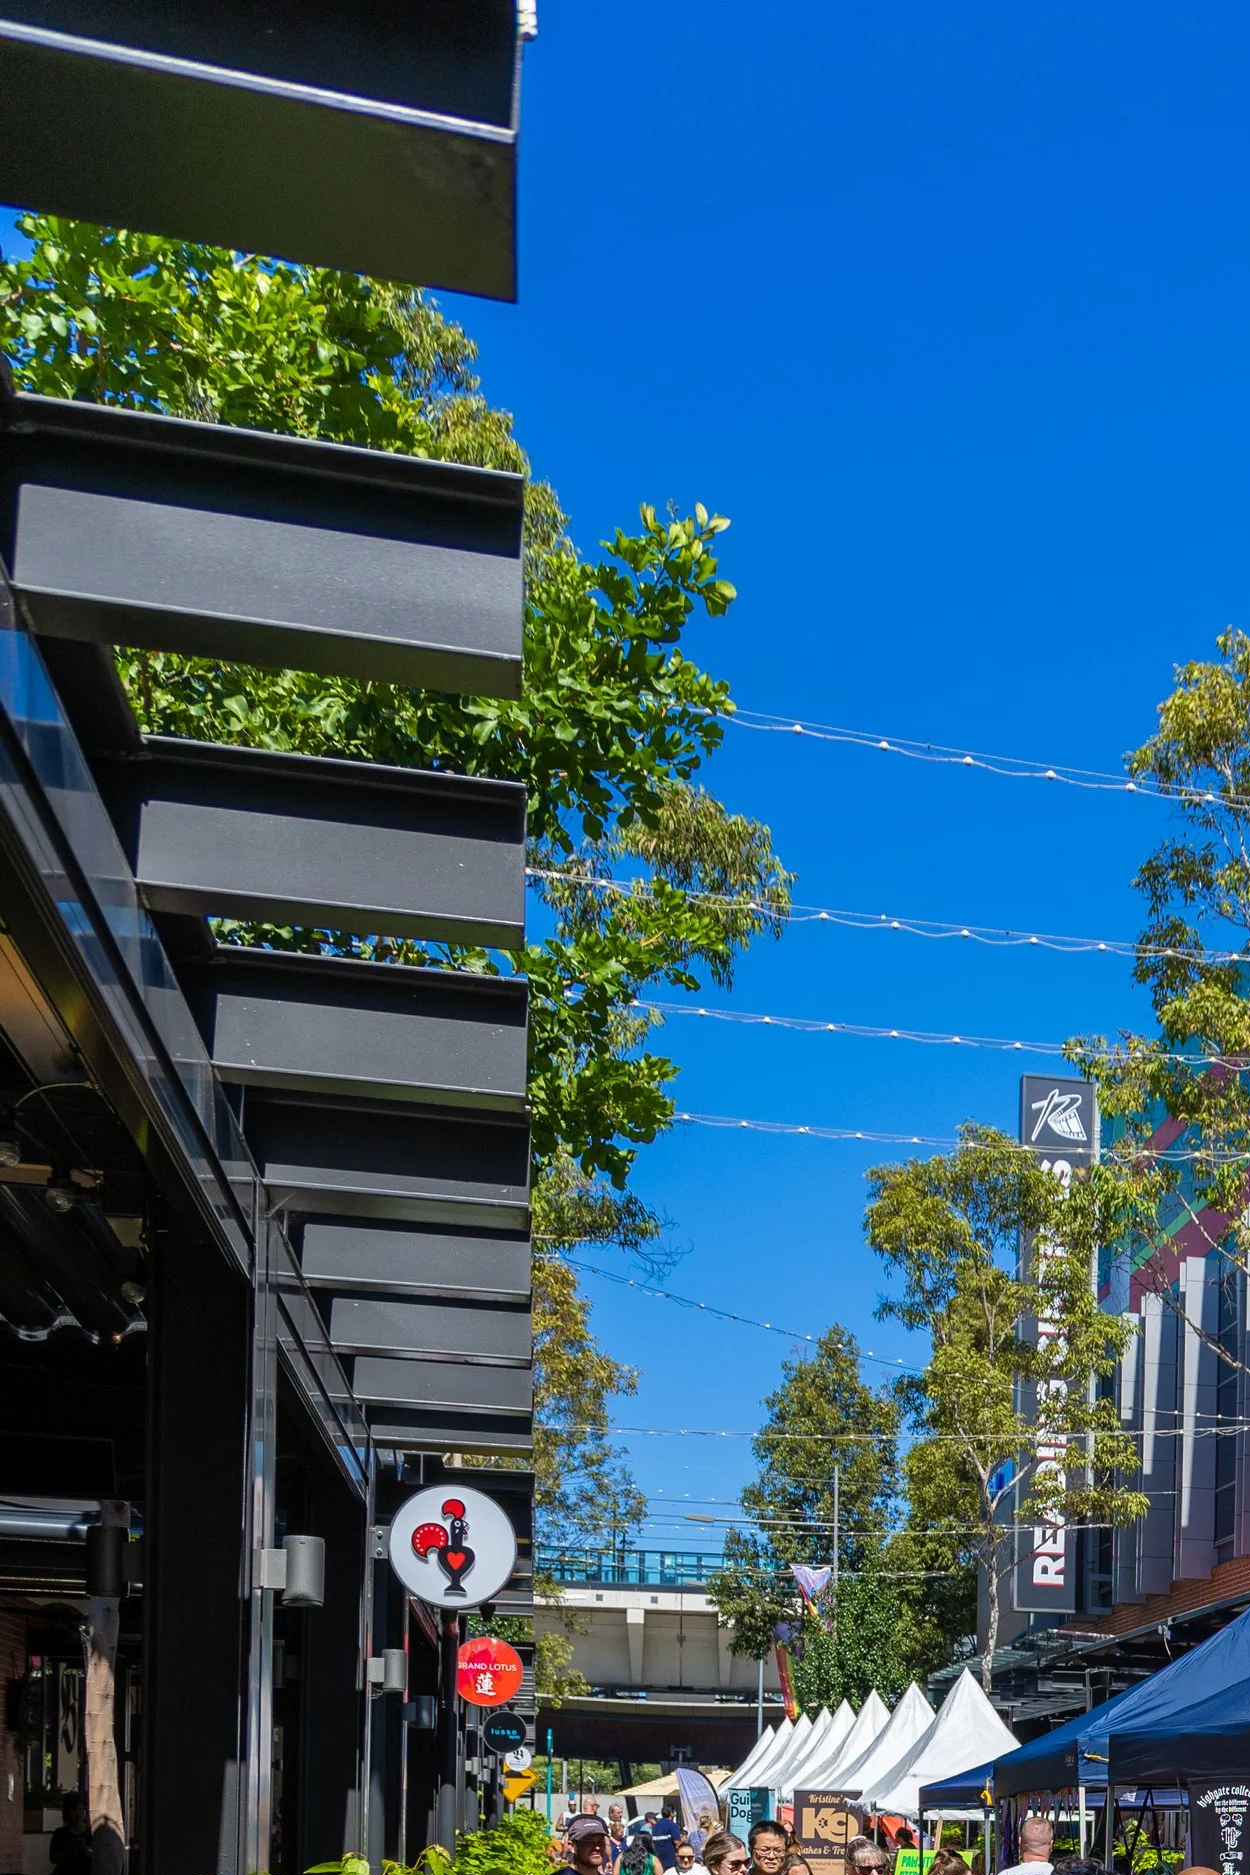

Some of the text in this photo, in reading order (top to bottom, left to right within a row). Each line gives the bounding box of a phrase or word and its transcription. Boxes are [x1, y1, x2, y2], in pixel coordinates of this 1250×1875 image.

[489, 1663, 518, 1672] LOTUS
[731, 1793, 750, 1805] Gui
[808, 1793, 843, 1804] Kristine'
[1197, 1786, 1230, 1808] highgate
[731, 1806, 752, 1823] Dog
[823, 1845, 831, 1855] &
